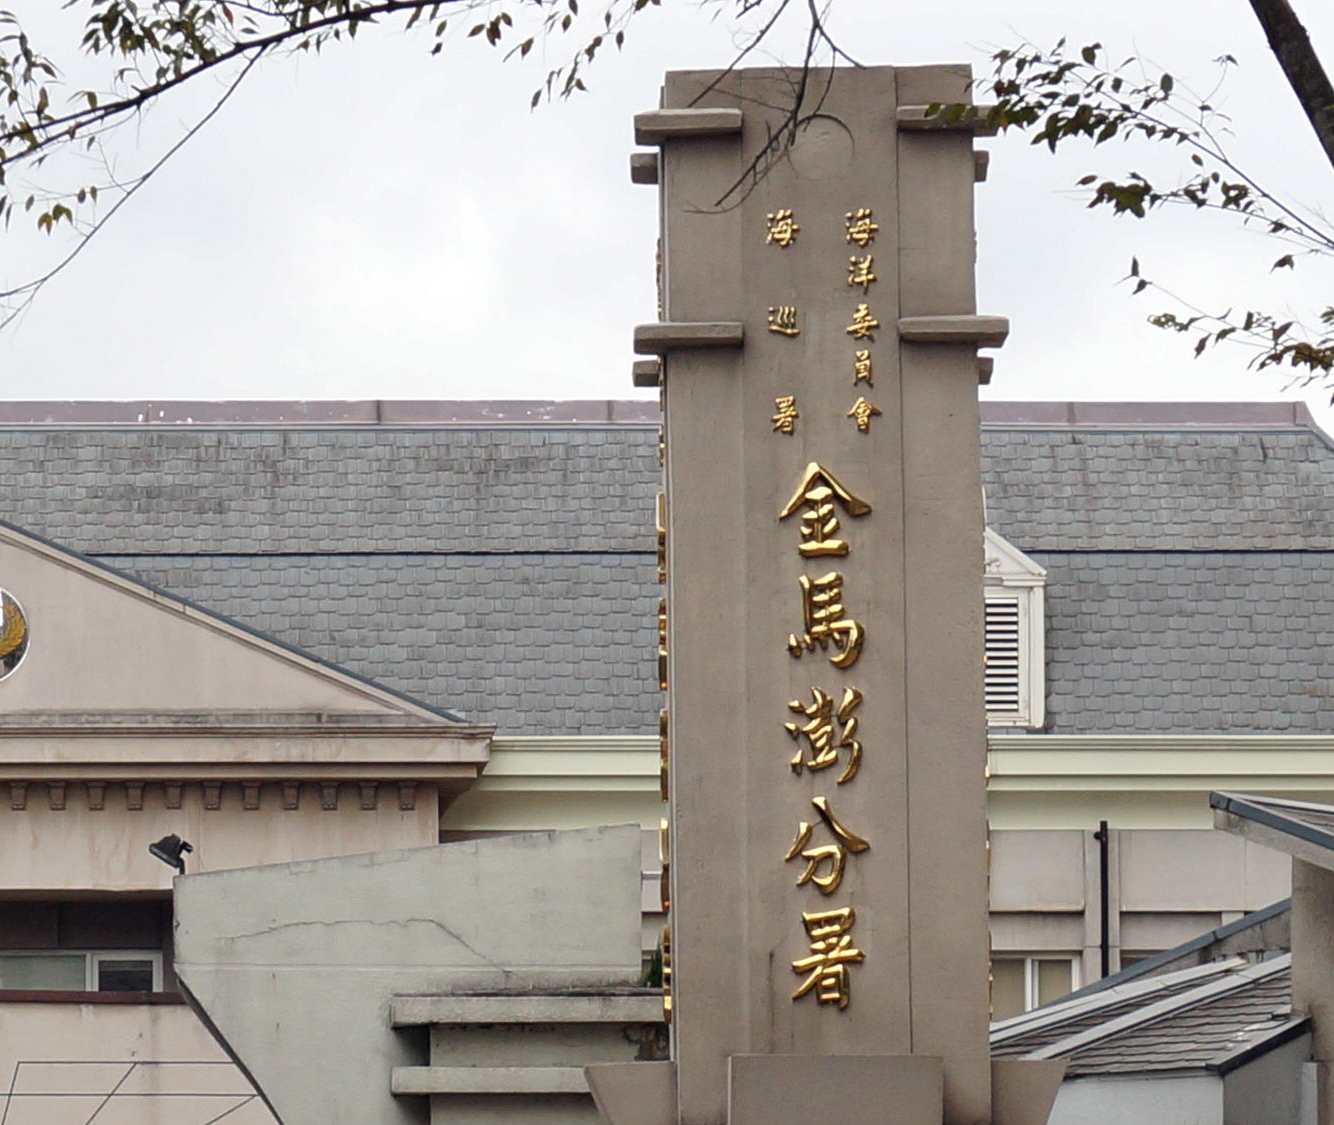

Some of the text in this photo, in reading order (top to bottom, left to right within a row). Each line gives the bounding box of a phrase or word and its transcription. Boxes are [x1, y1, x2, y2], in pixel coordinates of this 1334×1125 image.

[765, 208, 801, 436] 海巡署
[844, 207, 882, 433] 海洋委員會
[778, 460, 874, 1011] 金馬澎分署
